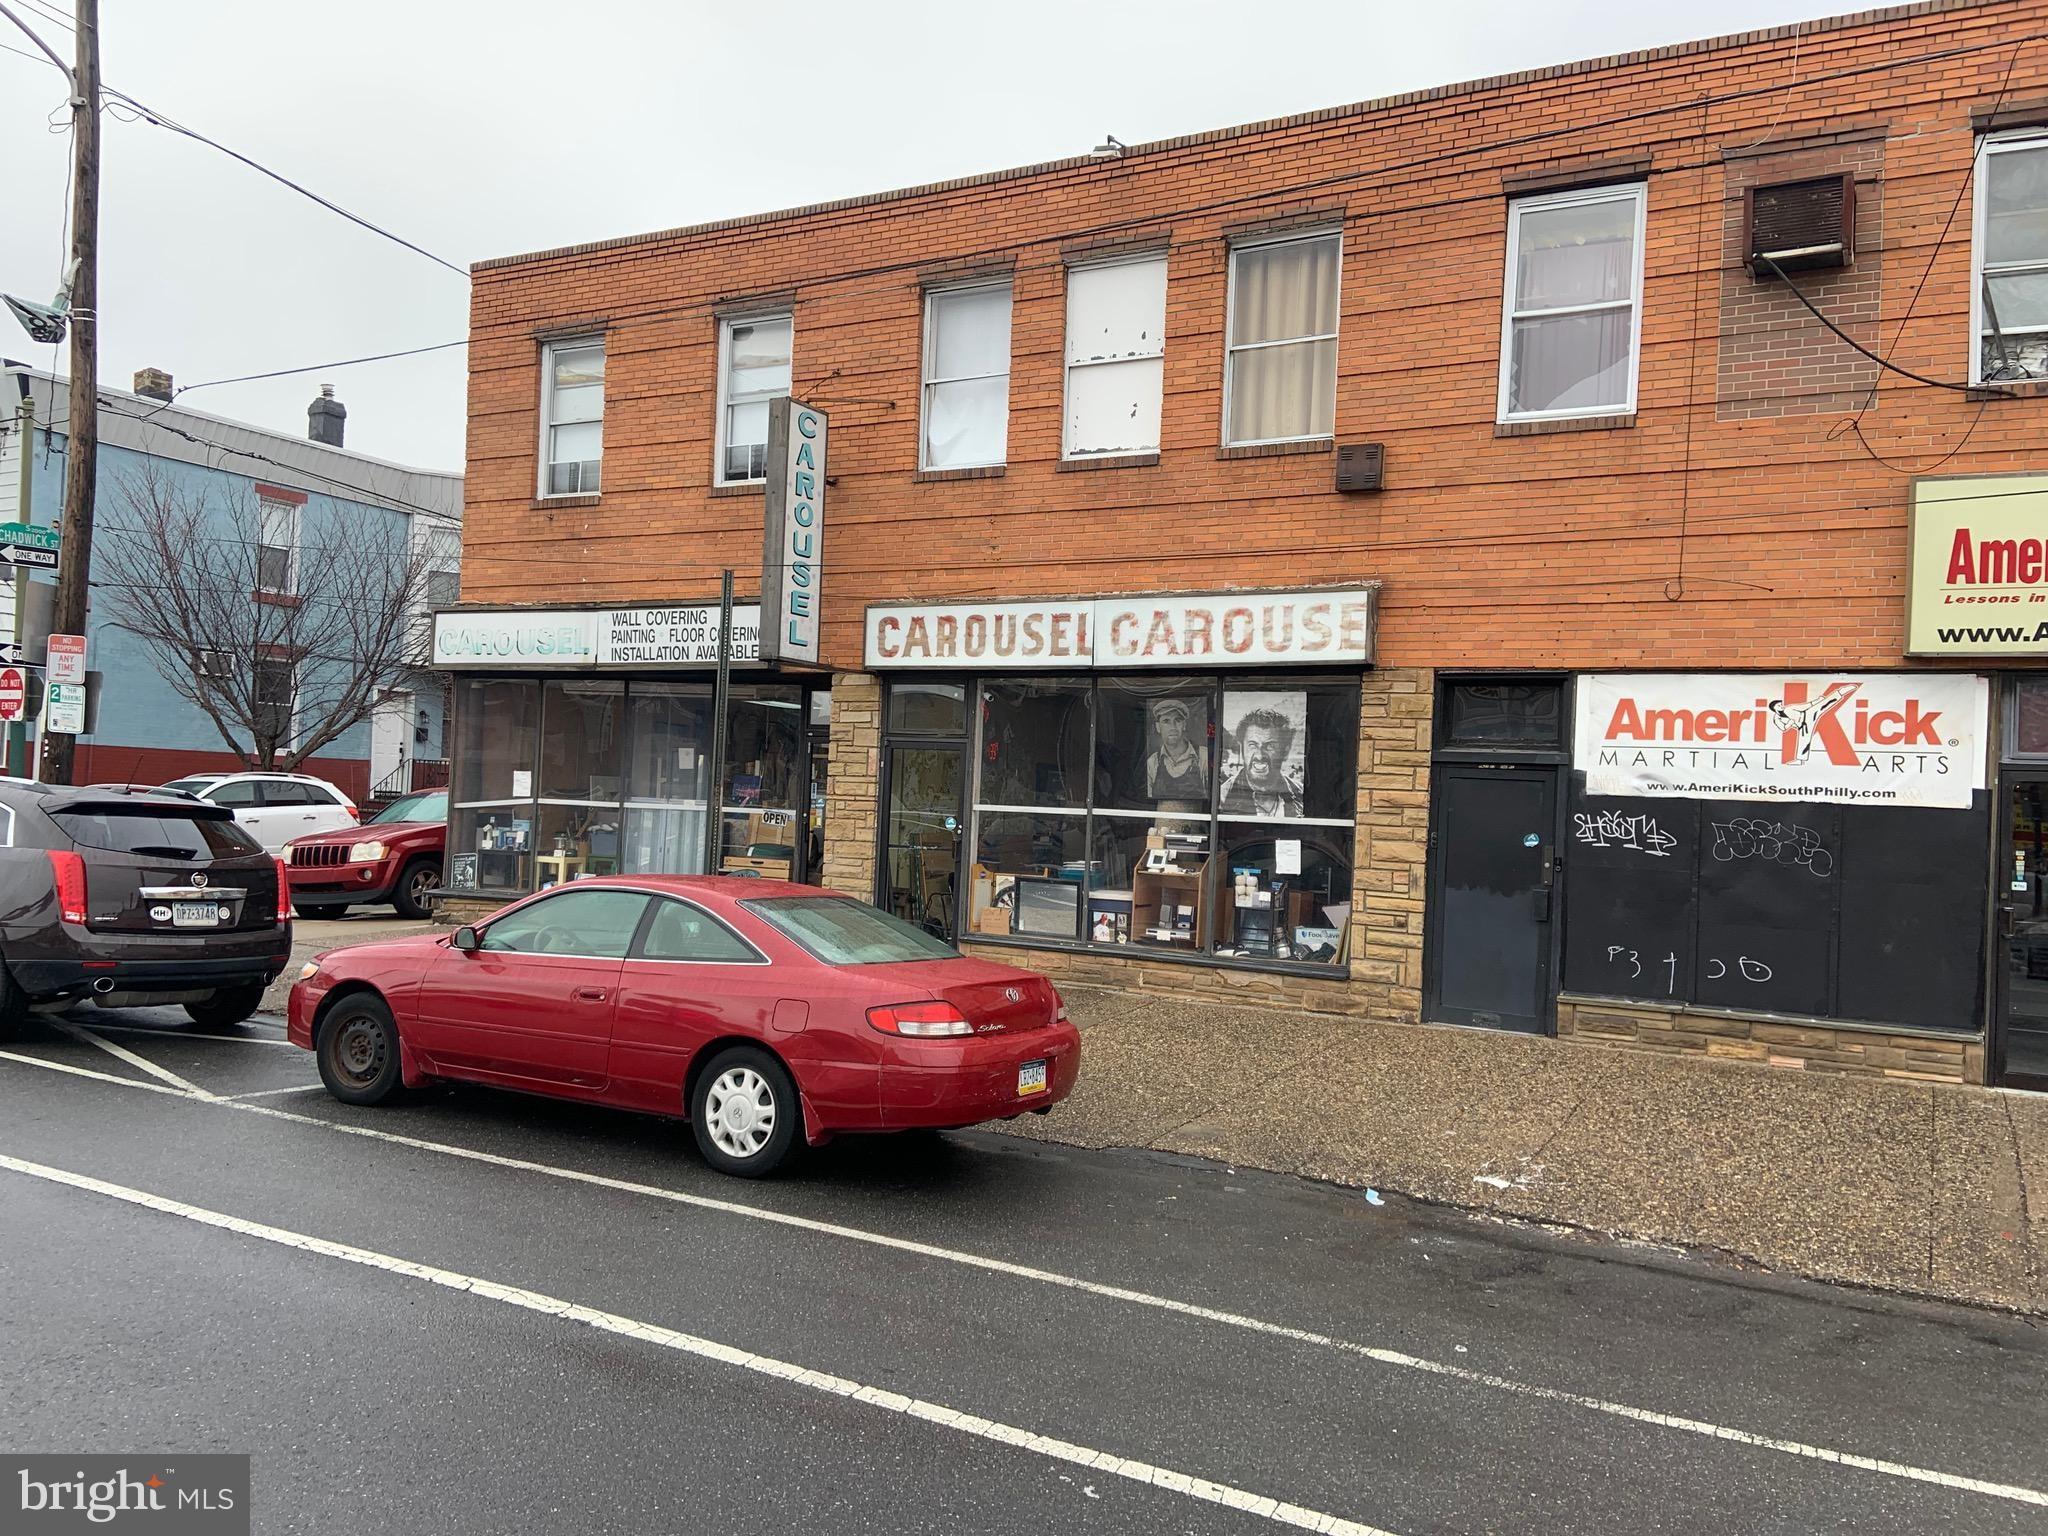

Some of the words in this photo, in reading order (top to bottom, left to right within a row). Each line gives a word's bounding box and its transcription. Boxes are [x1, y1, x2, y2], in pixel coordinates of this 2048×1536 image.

[788, 411, 818, 647] CAROUSEL
[0, 528, 48, 547] CHADWICK
[50, 540, 58, 548] ST
[15, 550, 32, 560] ONE
[35, 552, 52, 562] WAY
[1946, 527, 2048, 585] Ame
[1944, 594, 2021, 604] Lessons
[2029, 592, 2046, 603] in
[612, 612, 641, 627] WALL
[646, 609, 708, 626] COVERING
[611, 629, 656, 643] PAINTING
[669, 628, 704, 643] FLOOR
[709, 627, 760, 642] CERIN
[877, 612, 1093, 658] CAROUSEL
[1111, 603, 1367, 656] CAROUSE
[51, 644, 82, 652] STOPPING
[438, 627, 590, 656] CAROUSEL
[611, 646, 689, 661] INSTALLATION
[695, 644, 759, 660] AVAIABLE
[58, 663, 75, 671] TIME
[0, 678, 9, 687] DO
[10, 679, 20, 688] NOT
[51, 686, 60, 699] 2
[1, 702, 18, 710] ENTER
[1599, 750, 1774, 770] MARTIAL
[1862, 755, 1949, 774] ARTS
[763, 811, 787, 825] OPEN
